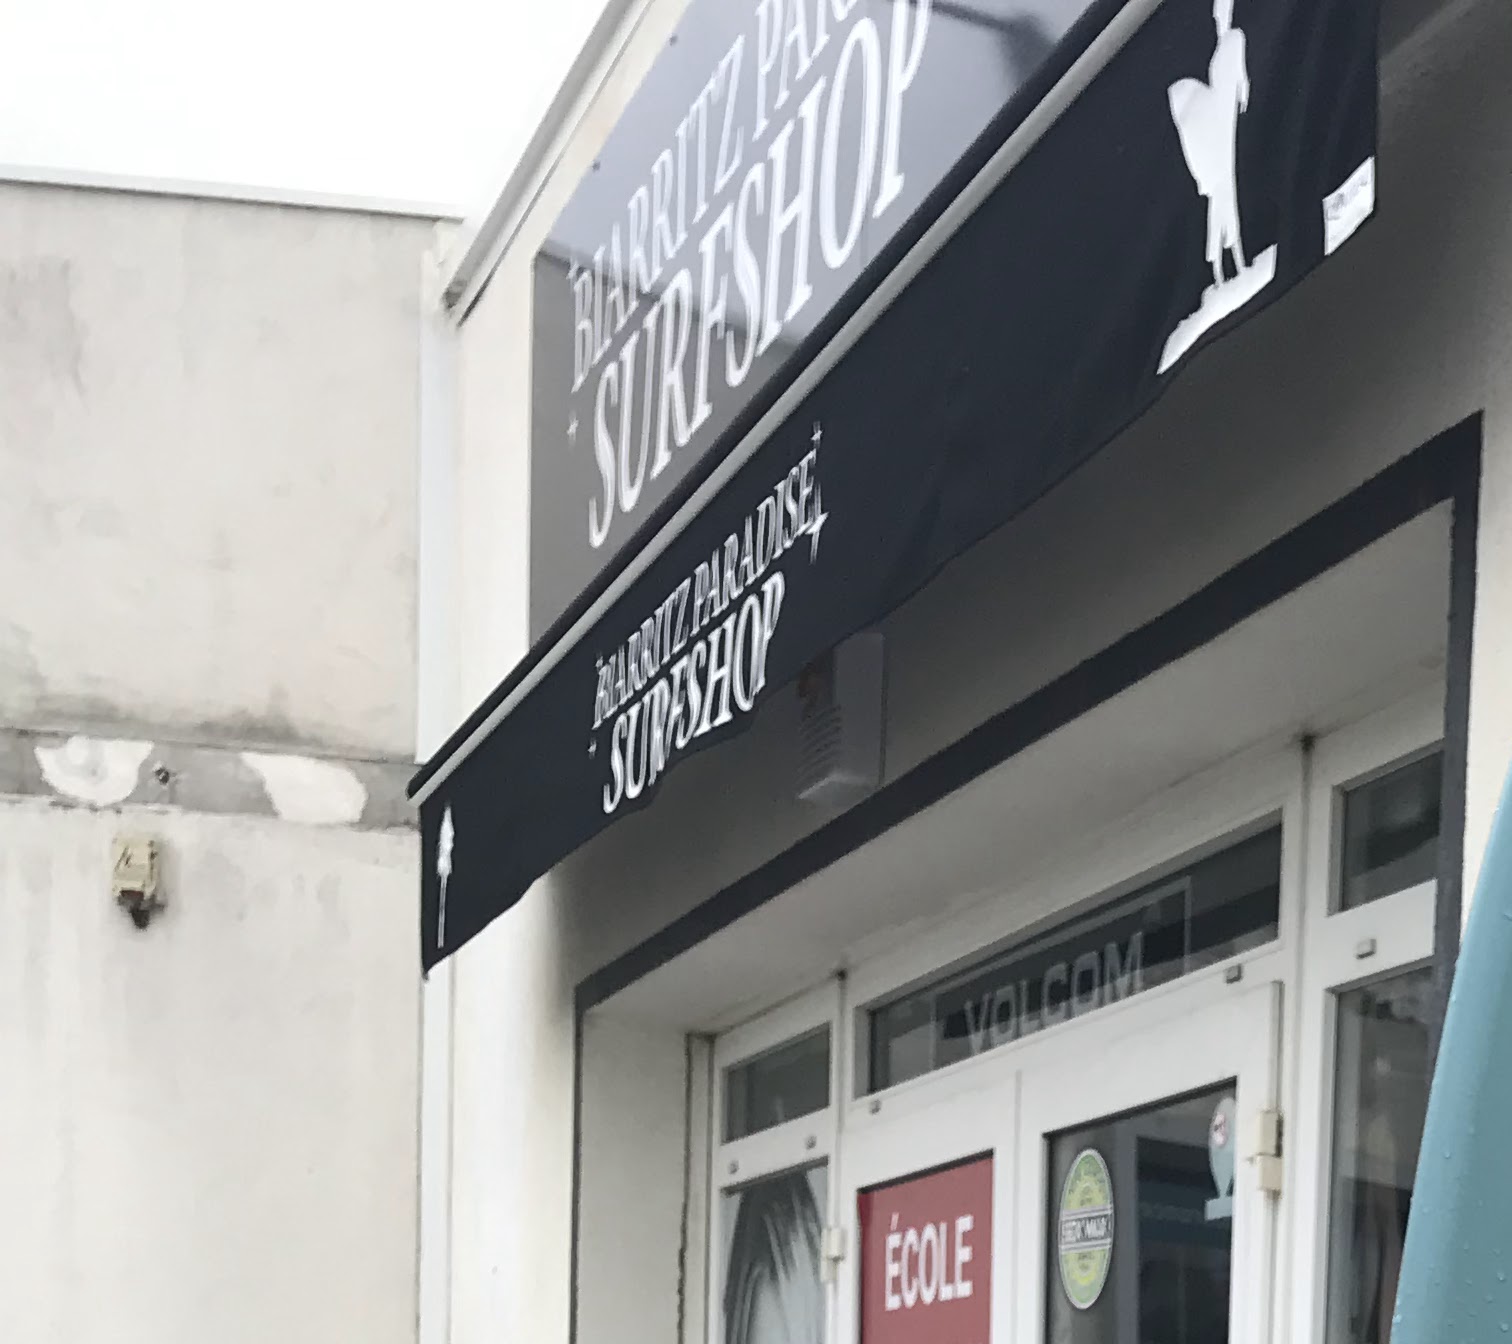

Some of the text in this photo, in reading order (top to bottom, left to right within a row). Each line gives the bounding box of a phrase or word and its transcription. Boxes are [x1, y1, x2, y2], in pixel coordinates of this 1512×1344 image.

[571, 34, 745, 393] BIARRITZ
[588, 0, 932, 548] SURFSHOP
[592, 449, 817, 730] BIARRITZ PARADISE
[603, 571, 786, 814] SURFSHOP
[963, 931, 1144, 1056] VOLCOM
[884, 1211, 974, 1312] ÉCOLE
